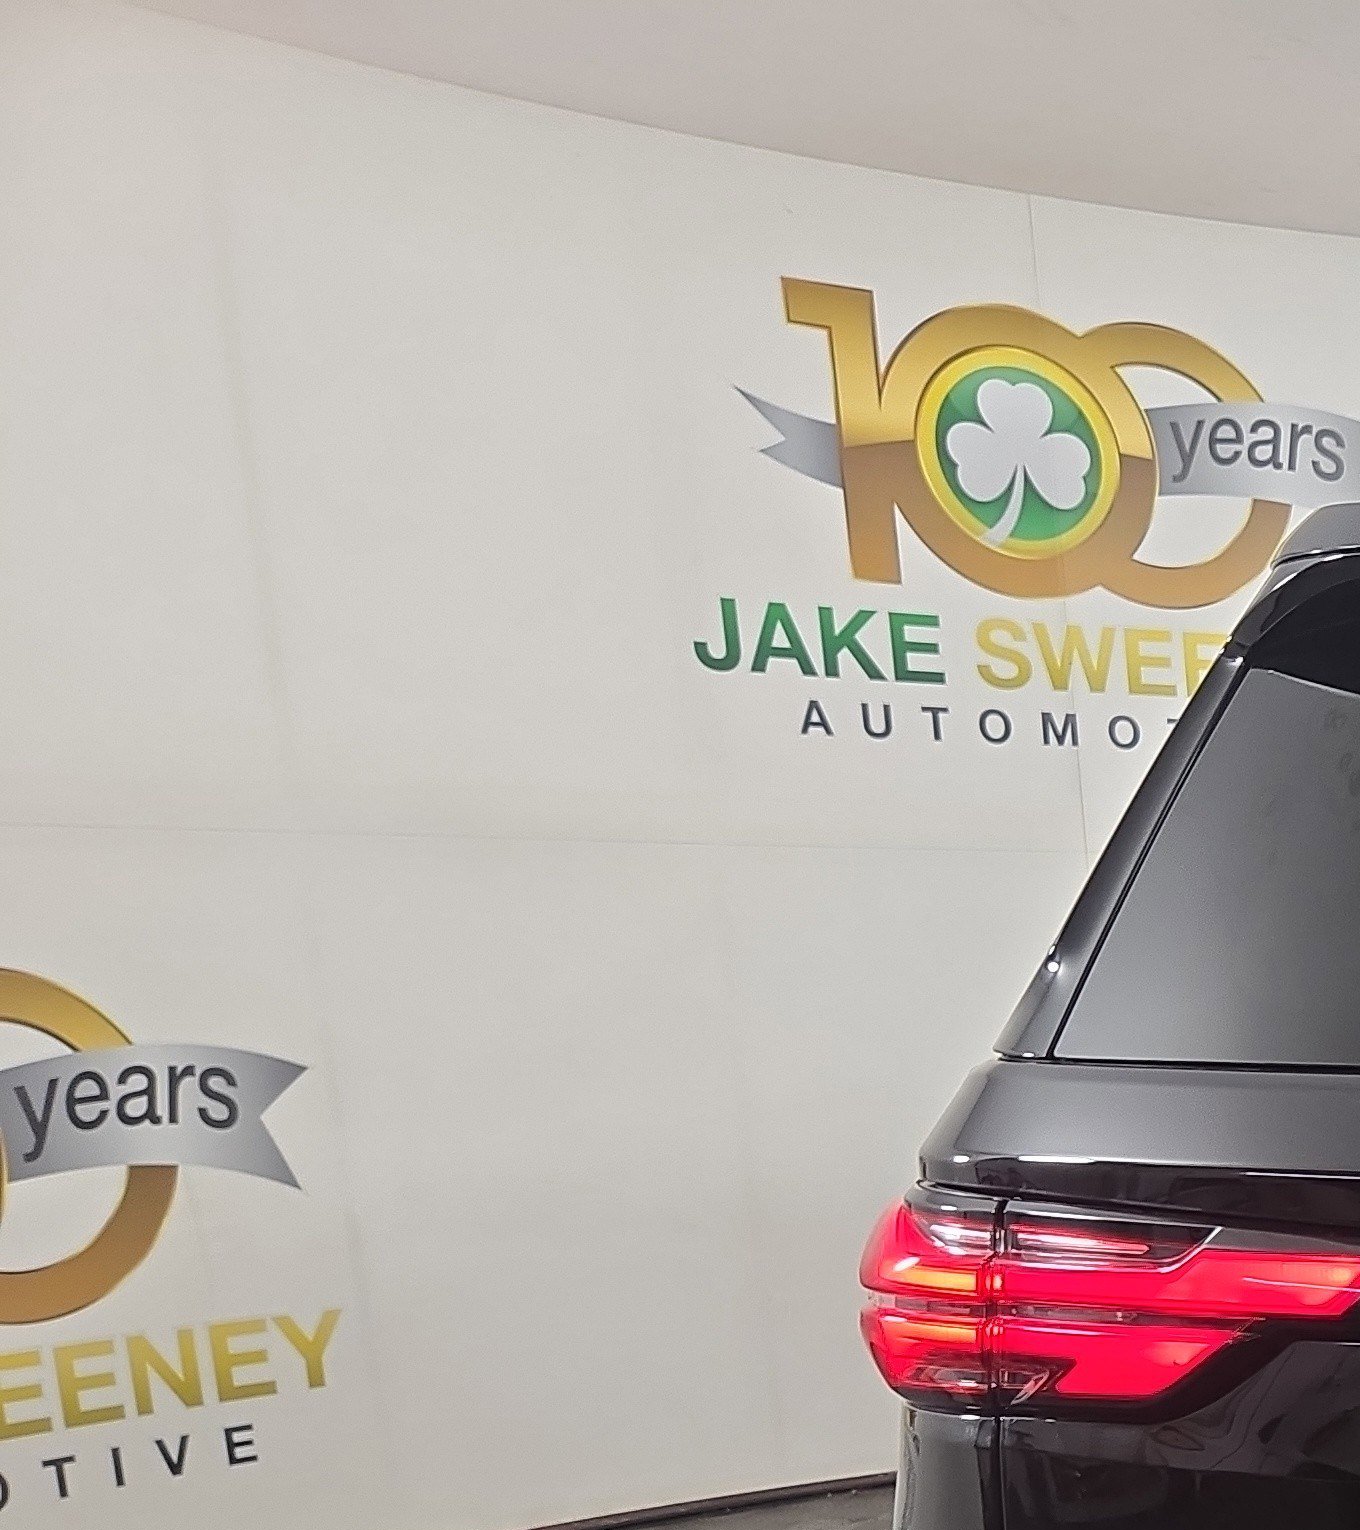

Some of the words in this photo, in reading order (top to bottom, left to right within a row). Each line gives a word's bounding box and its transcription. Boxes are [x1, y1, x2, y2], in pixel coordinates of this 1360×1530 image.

[1170, 416, 1347, 484] years
[693, 597, 947, 686] JAKE
[800, 700, 1179, 750] AUTOMO
[13, 1062, 239, 1163] years
